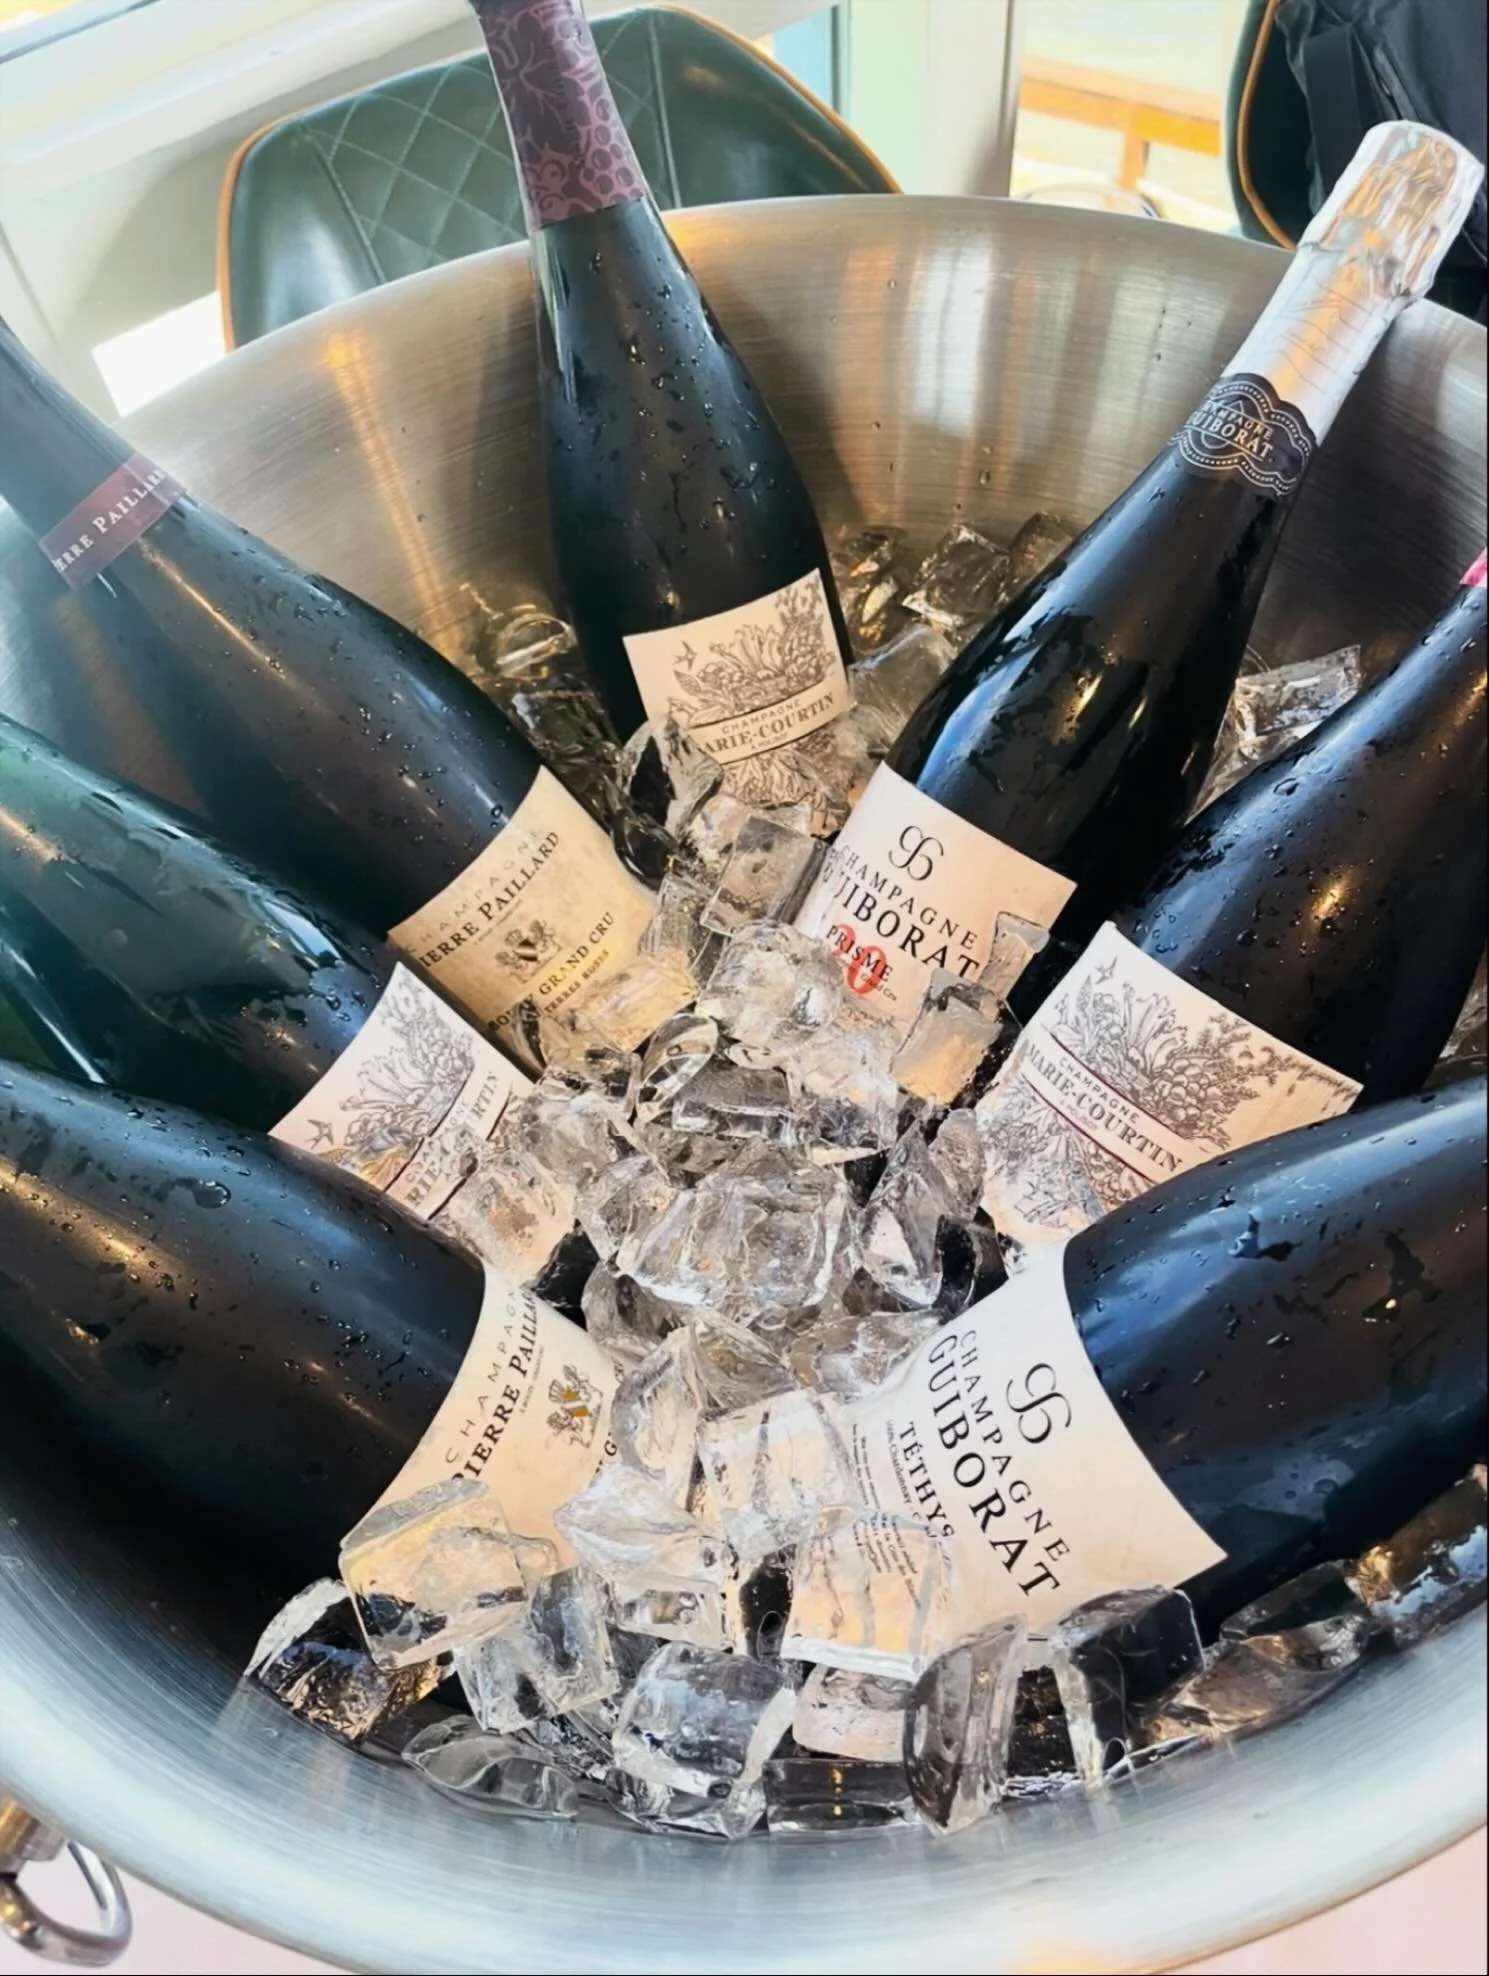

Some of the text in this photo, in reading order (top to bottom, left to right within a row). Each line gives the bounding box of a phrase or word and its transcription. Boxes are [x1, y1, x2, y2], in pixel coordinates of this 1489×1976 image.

[418, 831, 560, 968] IERRE PAILLARD
[839, 845, 978, 951] CHAMPAGNE
[539, 945, 590, 995] GRAND
[588, 912, 615, 944] CRU
[826, 925, 894, 982] PRISME
[1059, 1056, 1141, 1124] CHAMPAGNE
[928, 1335, 1060, 1597] GUIBORAT
[955, 1330, 1070, 1562] CHAMPAGNE
